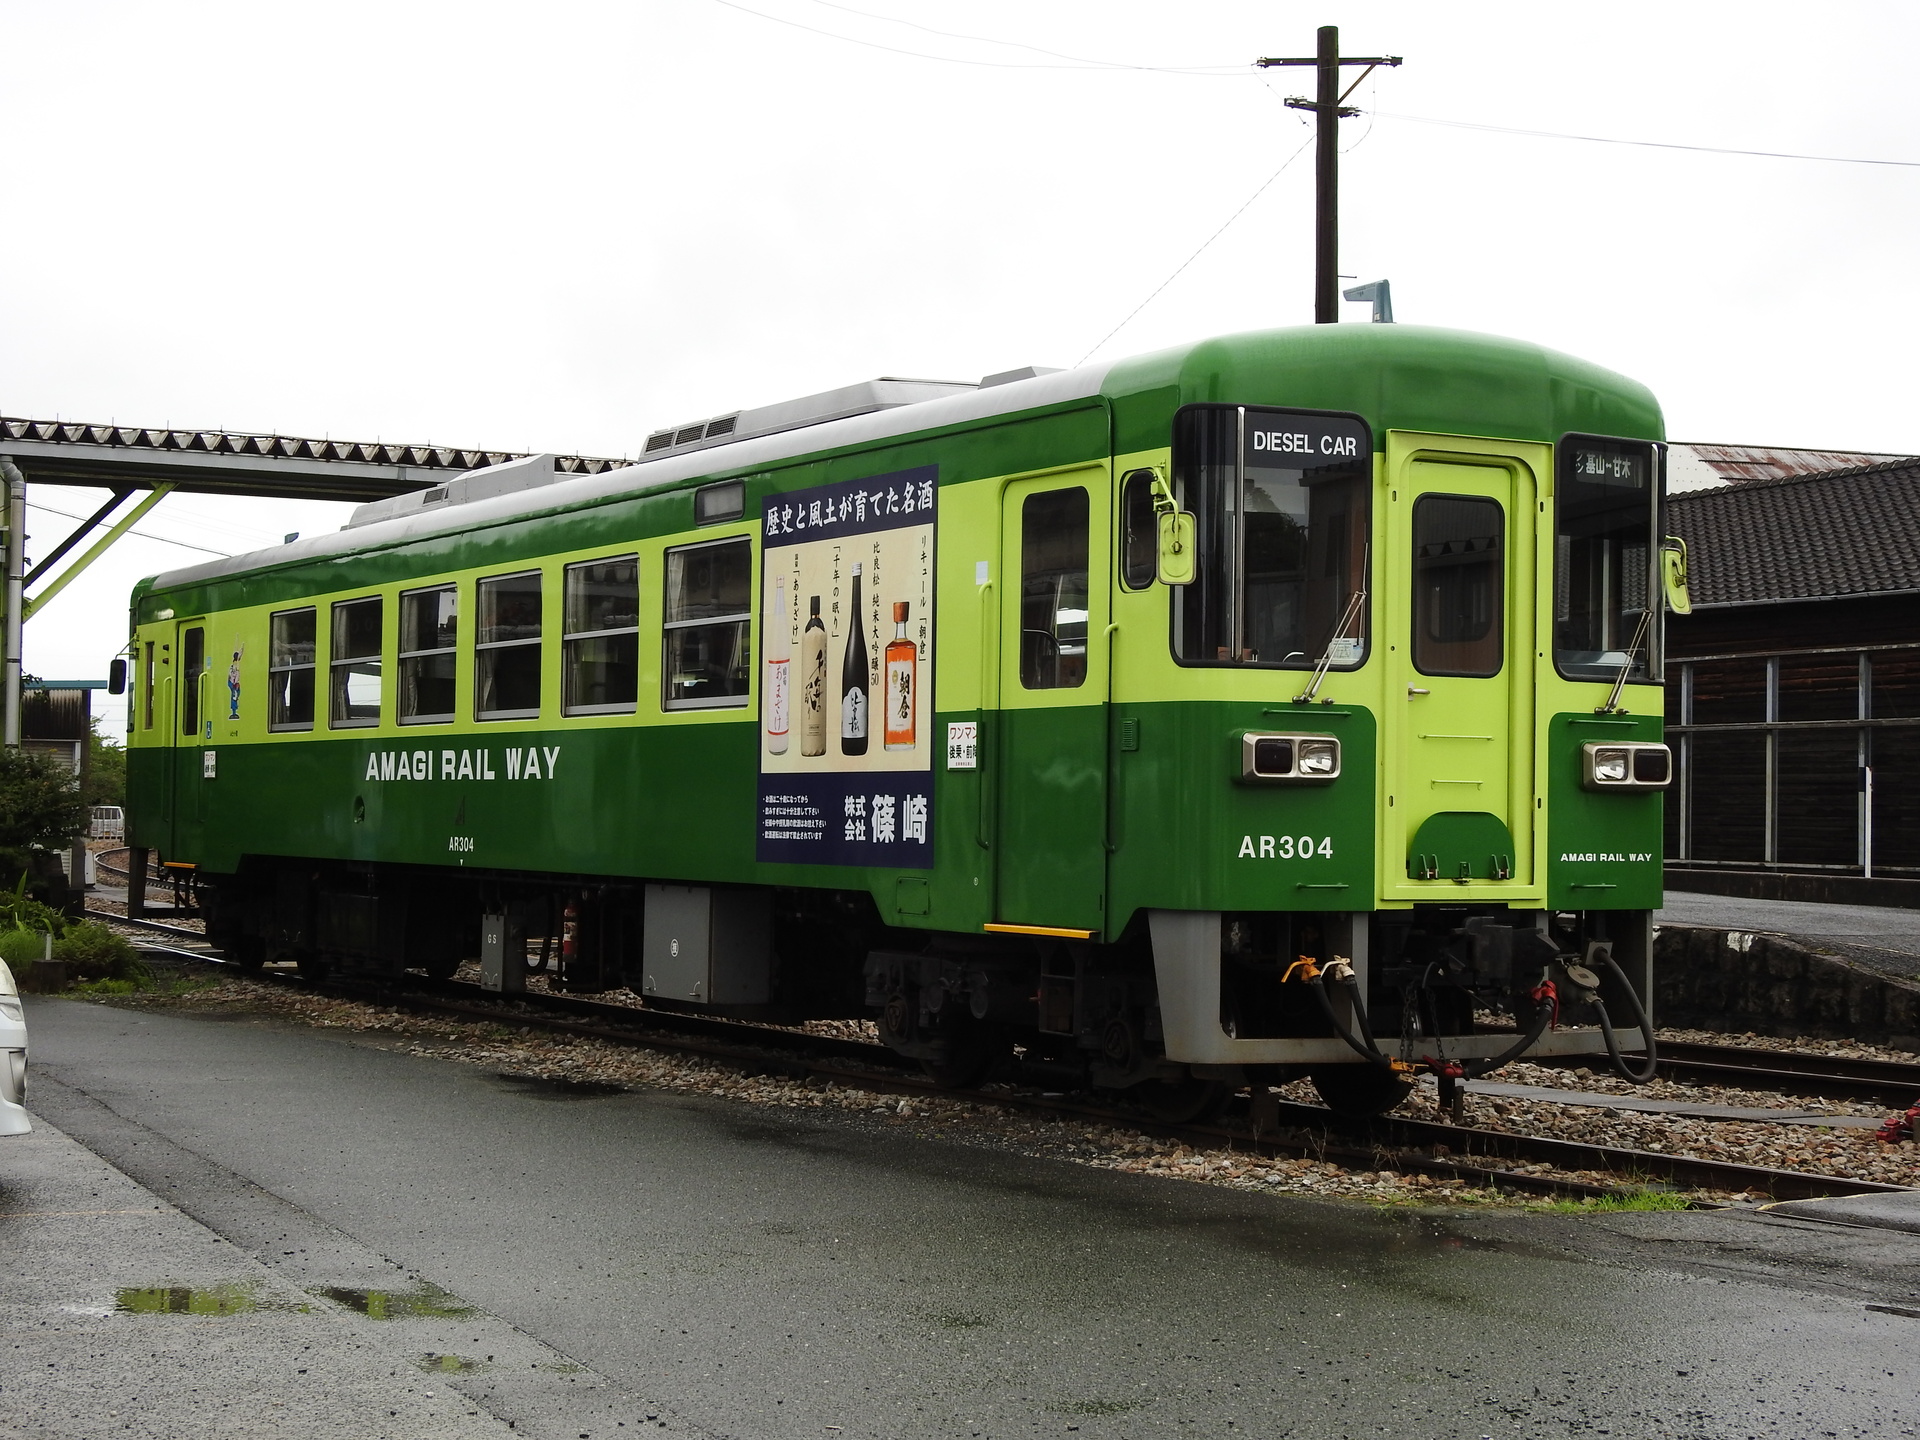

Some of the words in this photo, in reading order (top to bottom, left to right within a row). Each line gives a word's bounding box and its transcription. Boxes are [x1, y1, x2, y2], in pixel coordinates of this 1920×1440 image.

[1254, 431, 1314, 453] DIESEL
[1320, 435, 1357, 456] CAR
[1613, 456, 1631, 478] 甘木
[766, 479, 934, 537] 歴史と風土が育てた名酒
[950, 727, 977, 740] ワンマン
[365, 750, 433, 781] AMAGI
[441, 748, 496, 781] RAIL
[505, 746, 561, 780] WAY
[844, 795, 866, 817] 株式
[844, 819, 866, 841] 会社
[871, 794, 928, 844] 篠崎
[449, 836, 474, 852] AR304
[1238, 835, 1333, 859] AR304
[1560, 853, 1596, 862] AMAGI
[1600, 853, 1625, 862] RAIL
[1629, 853, 1652, 862] WAY
